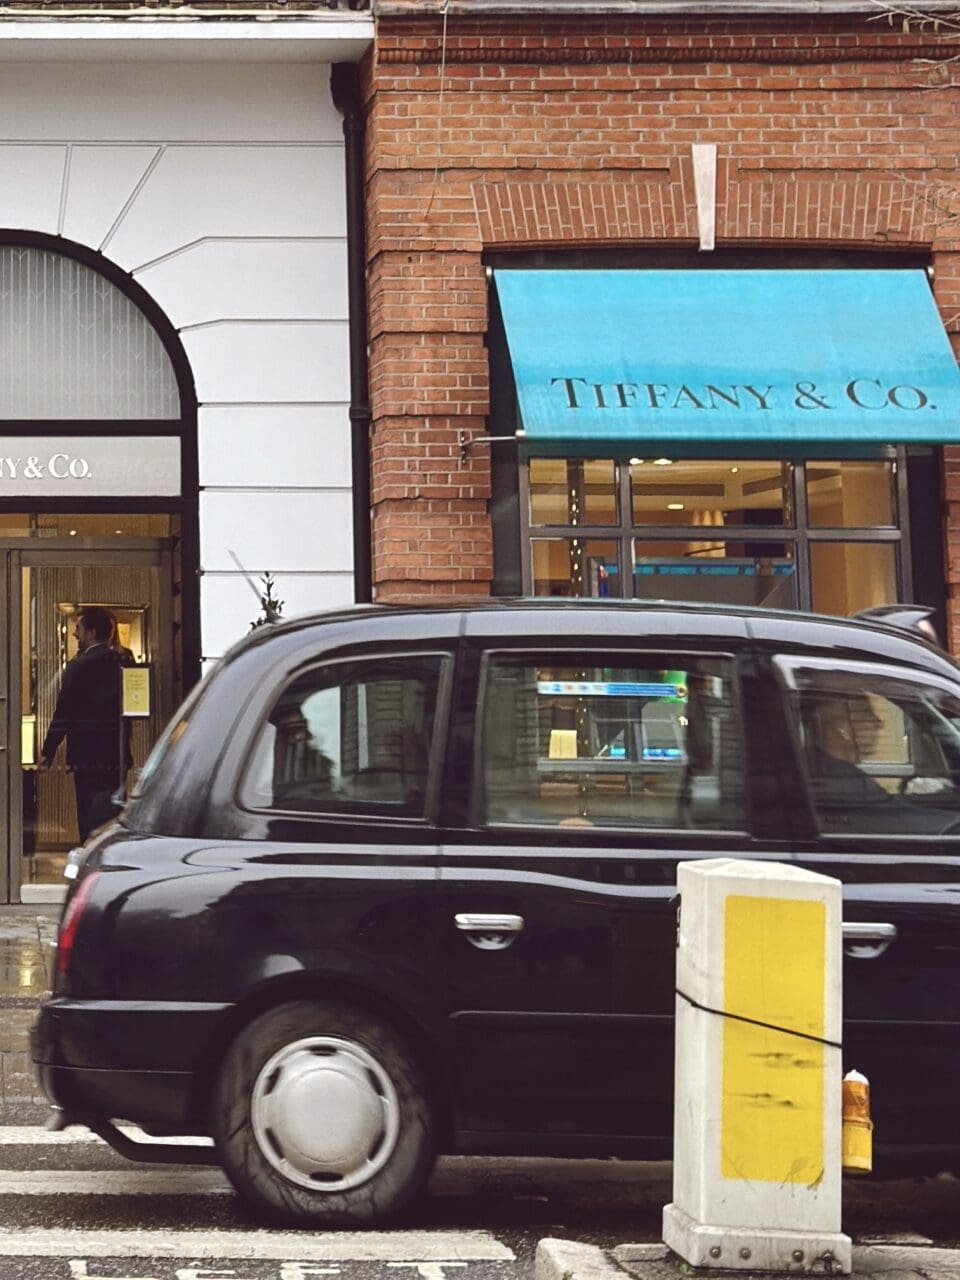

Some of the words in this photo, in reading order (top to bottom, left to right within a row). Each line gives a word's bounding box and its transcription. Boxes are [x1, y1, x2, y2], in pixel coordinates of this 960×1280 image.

[550, 377, 775, 410] TIFFANY
[795, 380, 837, 410] &
[23, 455, 47, 480] &
